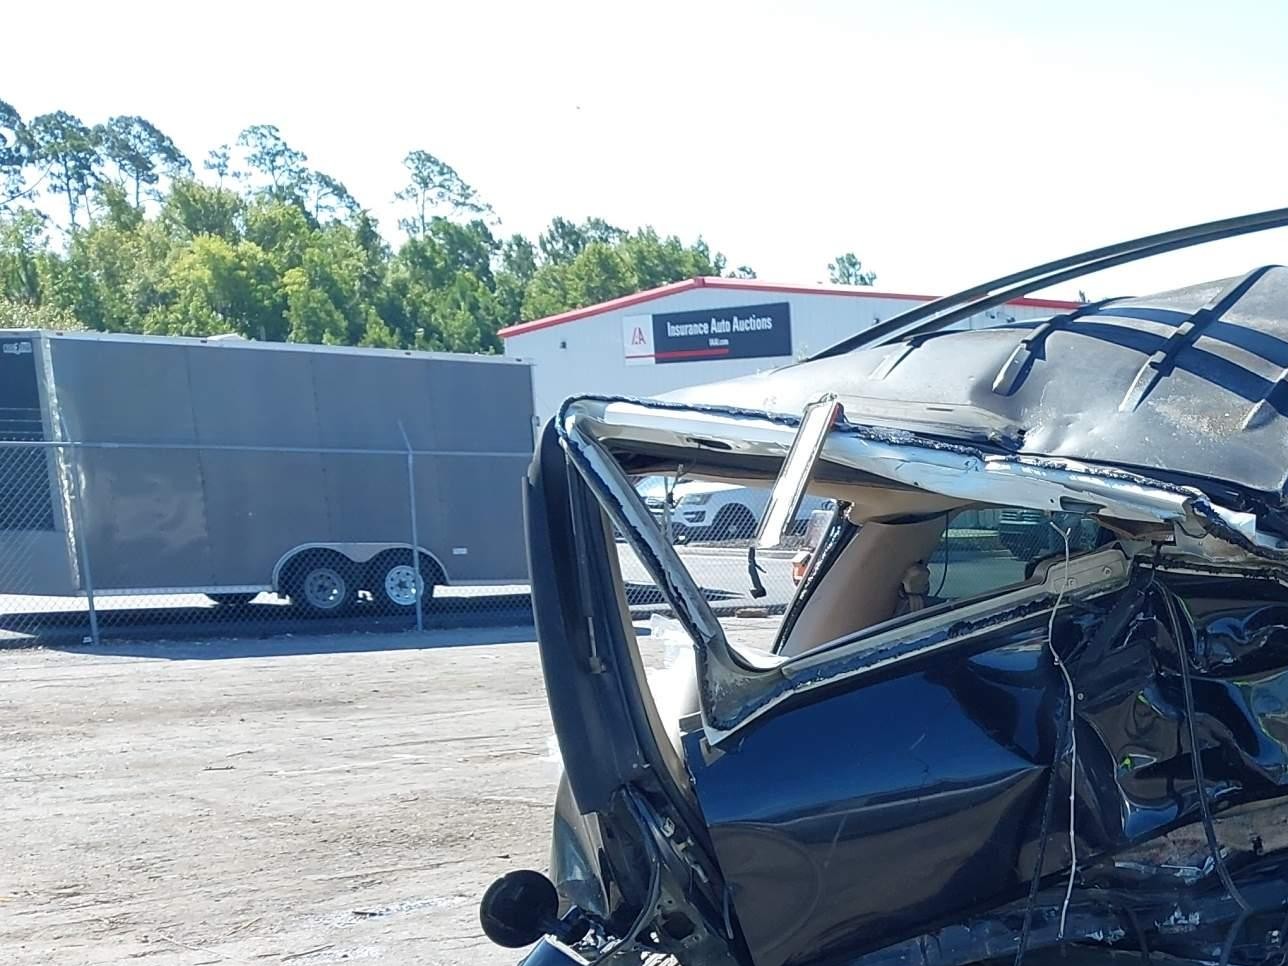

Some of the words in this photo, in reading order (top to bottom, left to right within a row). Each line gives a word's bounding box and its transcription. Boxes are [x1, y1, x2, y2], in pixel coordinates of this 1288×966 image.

[667, 321, 709, 337] Insurance
[710, 318, 731, 333] Auto
[732, 314, 773, 332] Auctions
